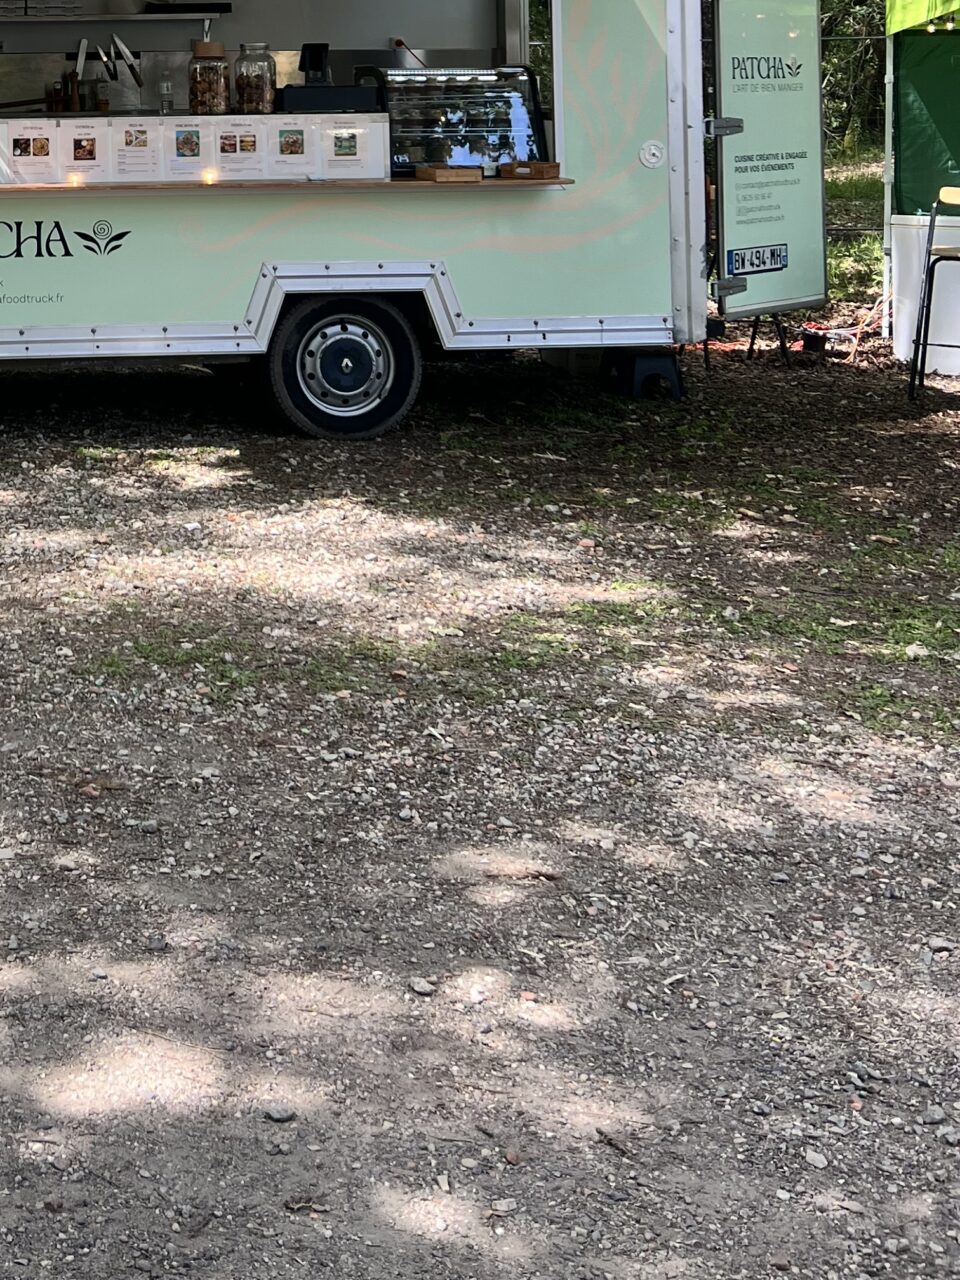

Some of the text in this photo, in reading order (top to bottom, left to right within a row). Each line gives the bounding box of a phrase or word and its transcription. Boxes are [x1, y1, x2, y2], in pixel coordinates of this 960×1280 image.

[731, 56, 786, 80] PATCHA
[750, 83, 759, 92] DE
[761, 83, 776, 92] BIEN
[777, 82, 804, 92] MANGER
[734, 154, 755, 163] CUISINE
[755, 152, 780, 162] CRÉATIVE
[734, 165, 749, 174] POUR
[749, 164, 760, 173] VOS
